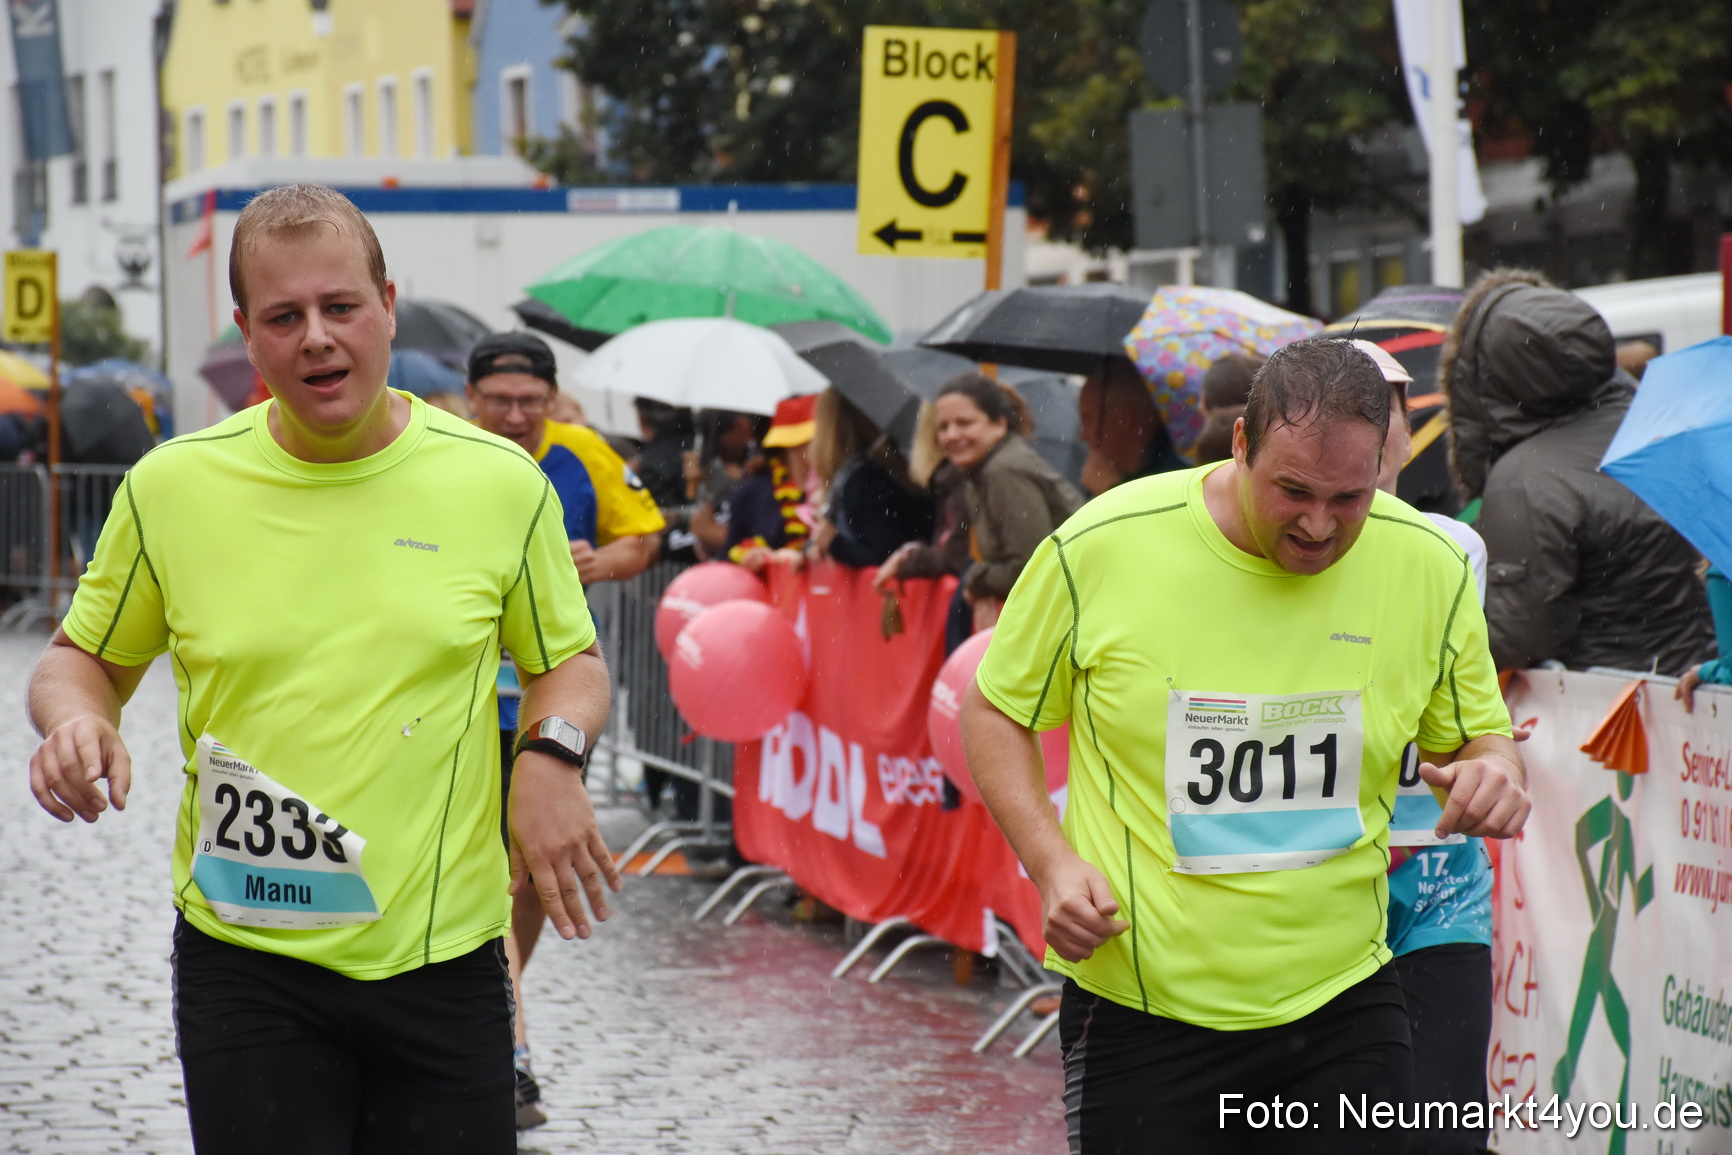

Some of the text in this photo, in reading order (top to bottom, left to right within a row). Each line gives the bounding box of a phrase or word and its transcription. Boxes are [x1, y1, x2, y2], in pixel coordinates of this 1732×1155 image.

[883, 38, 994, 81] Block
[896, 99, 970, 209] C
[17, 277, 43, 320] D
[1185, 713, 1249, 725] NeuerMarkt
[1261, 696, 1345, 722] BOCK
[1314, 716, 1347, 725] concepts
[1187, 733, 1337, 806] 3011
[203, 840, 212, 853] D
[1416, 852, 1449, 877] 17.
[245, 874, 312, 905] Manu
